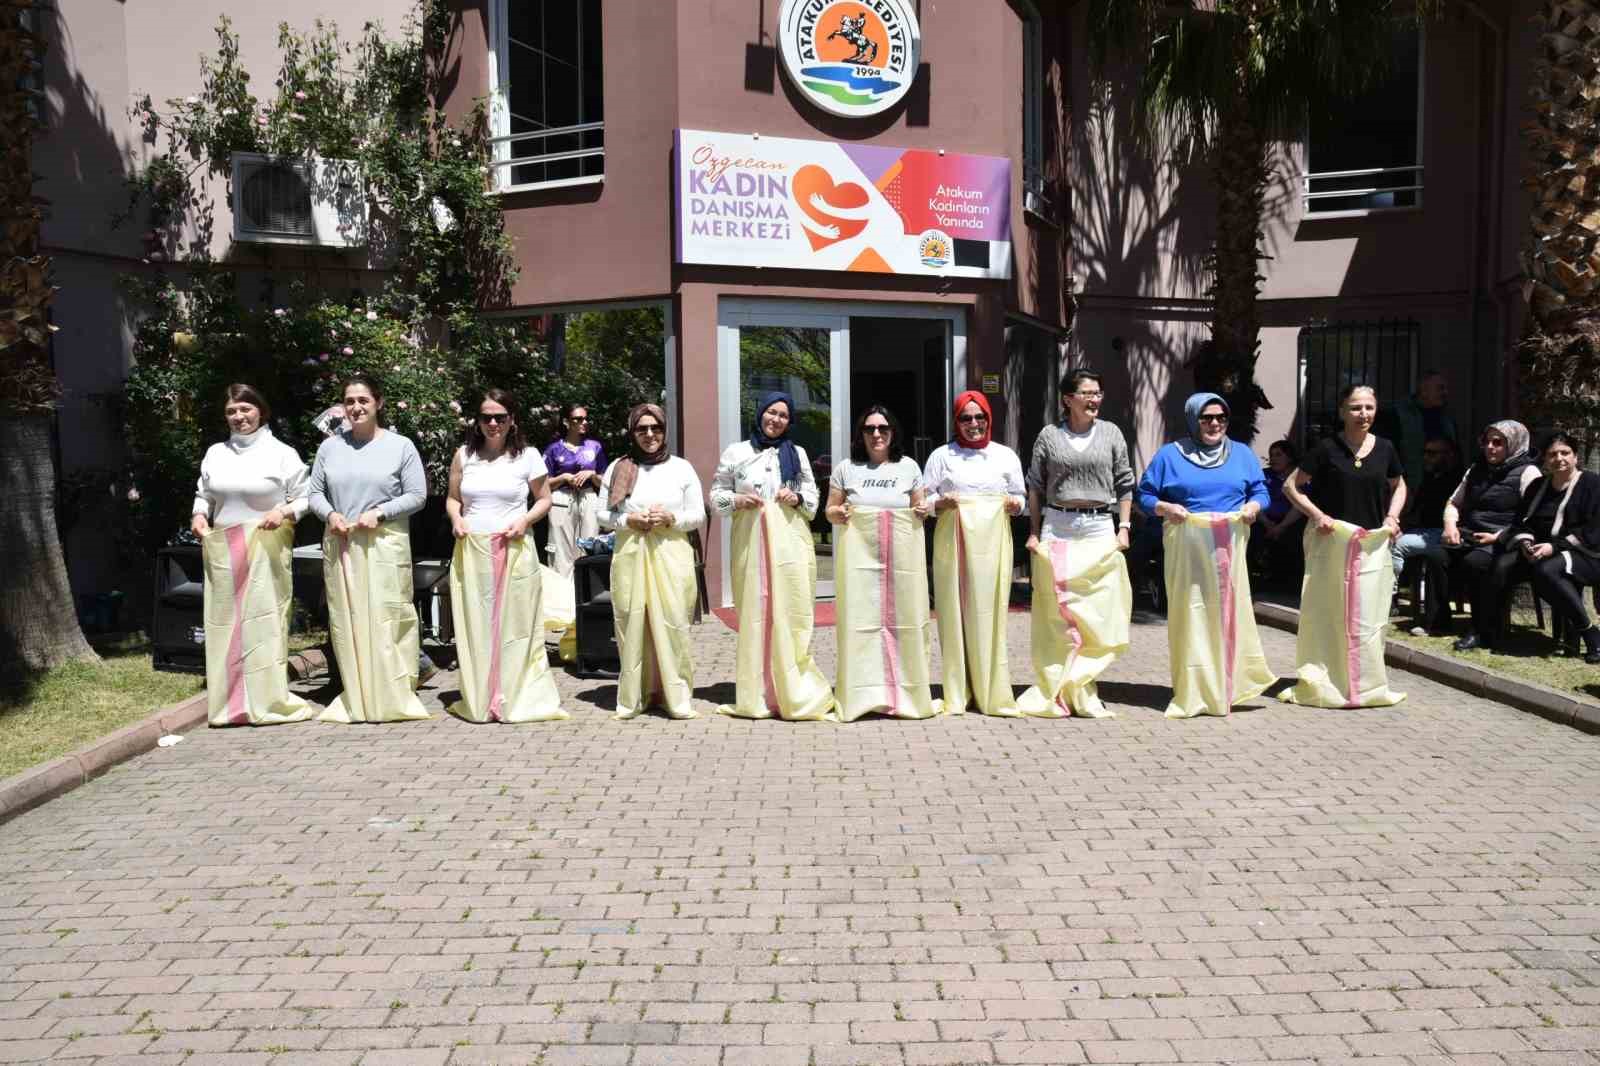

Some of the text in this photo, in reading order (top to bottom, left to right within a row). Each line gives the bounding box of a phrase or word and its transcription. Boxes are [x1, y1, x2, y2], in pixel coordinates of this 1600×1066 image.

[855, 66, 881, 76] 1994
[692, 143, 788, 183] Özgecan
[689, 169, 788, 198] KADIN
[935, 183, 983, 199] Atakum
[690, 198, 789, 219] DANIŞMA
[928, 197, 990, 215] Kadınların
[935, 212, 984, 229] Yanında
[862, 477, 899, 489] mavi
